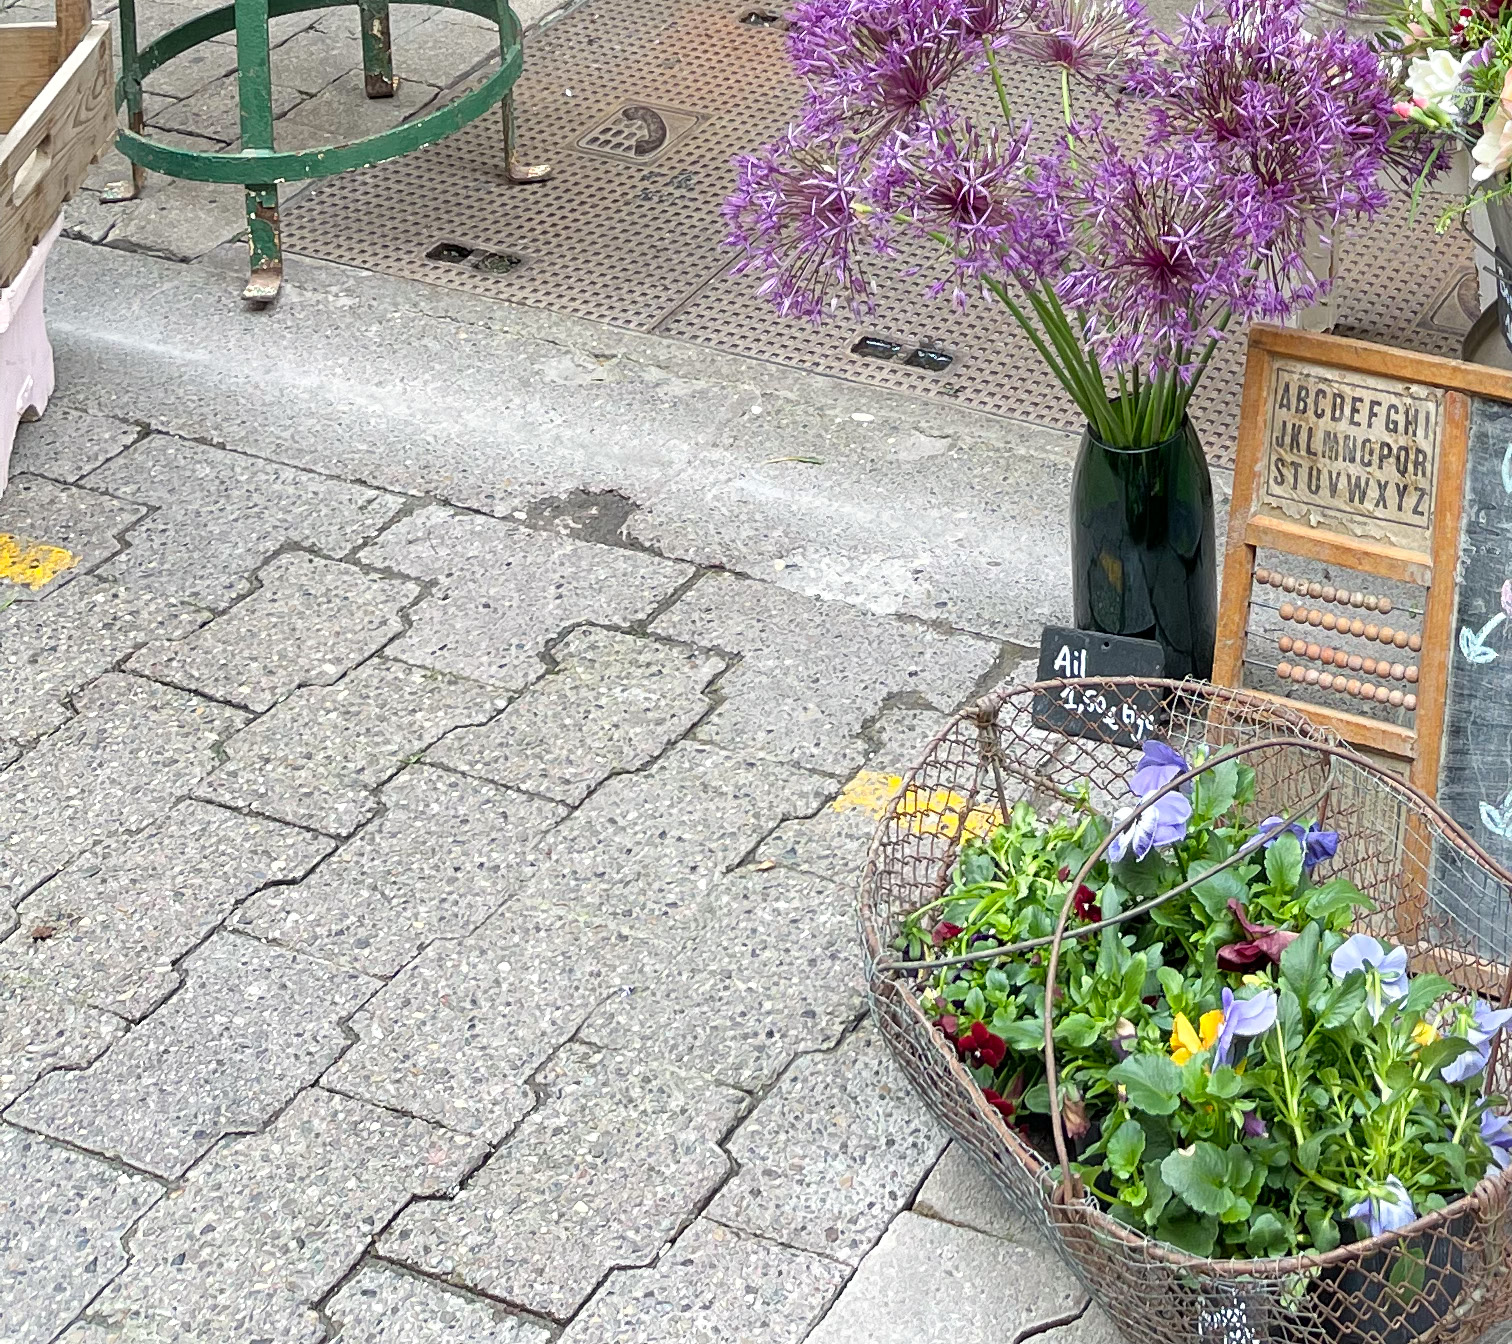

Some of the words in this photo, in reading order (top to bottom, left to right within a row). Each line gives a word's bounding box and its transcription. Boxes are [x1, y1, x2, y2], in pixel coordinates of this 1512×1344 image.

[1278, 380, 1430, 441] ABCDEFGHI
[1274, 419, 1428, 479] JKLMNOPQR
[1273, 457, 1427, 517] STUVWXYZ
[1053, 644, 1087, 679] Ail
